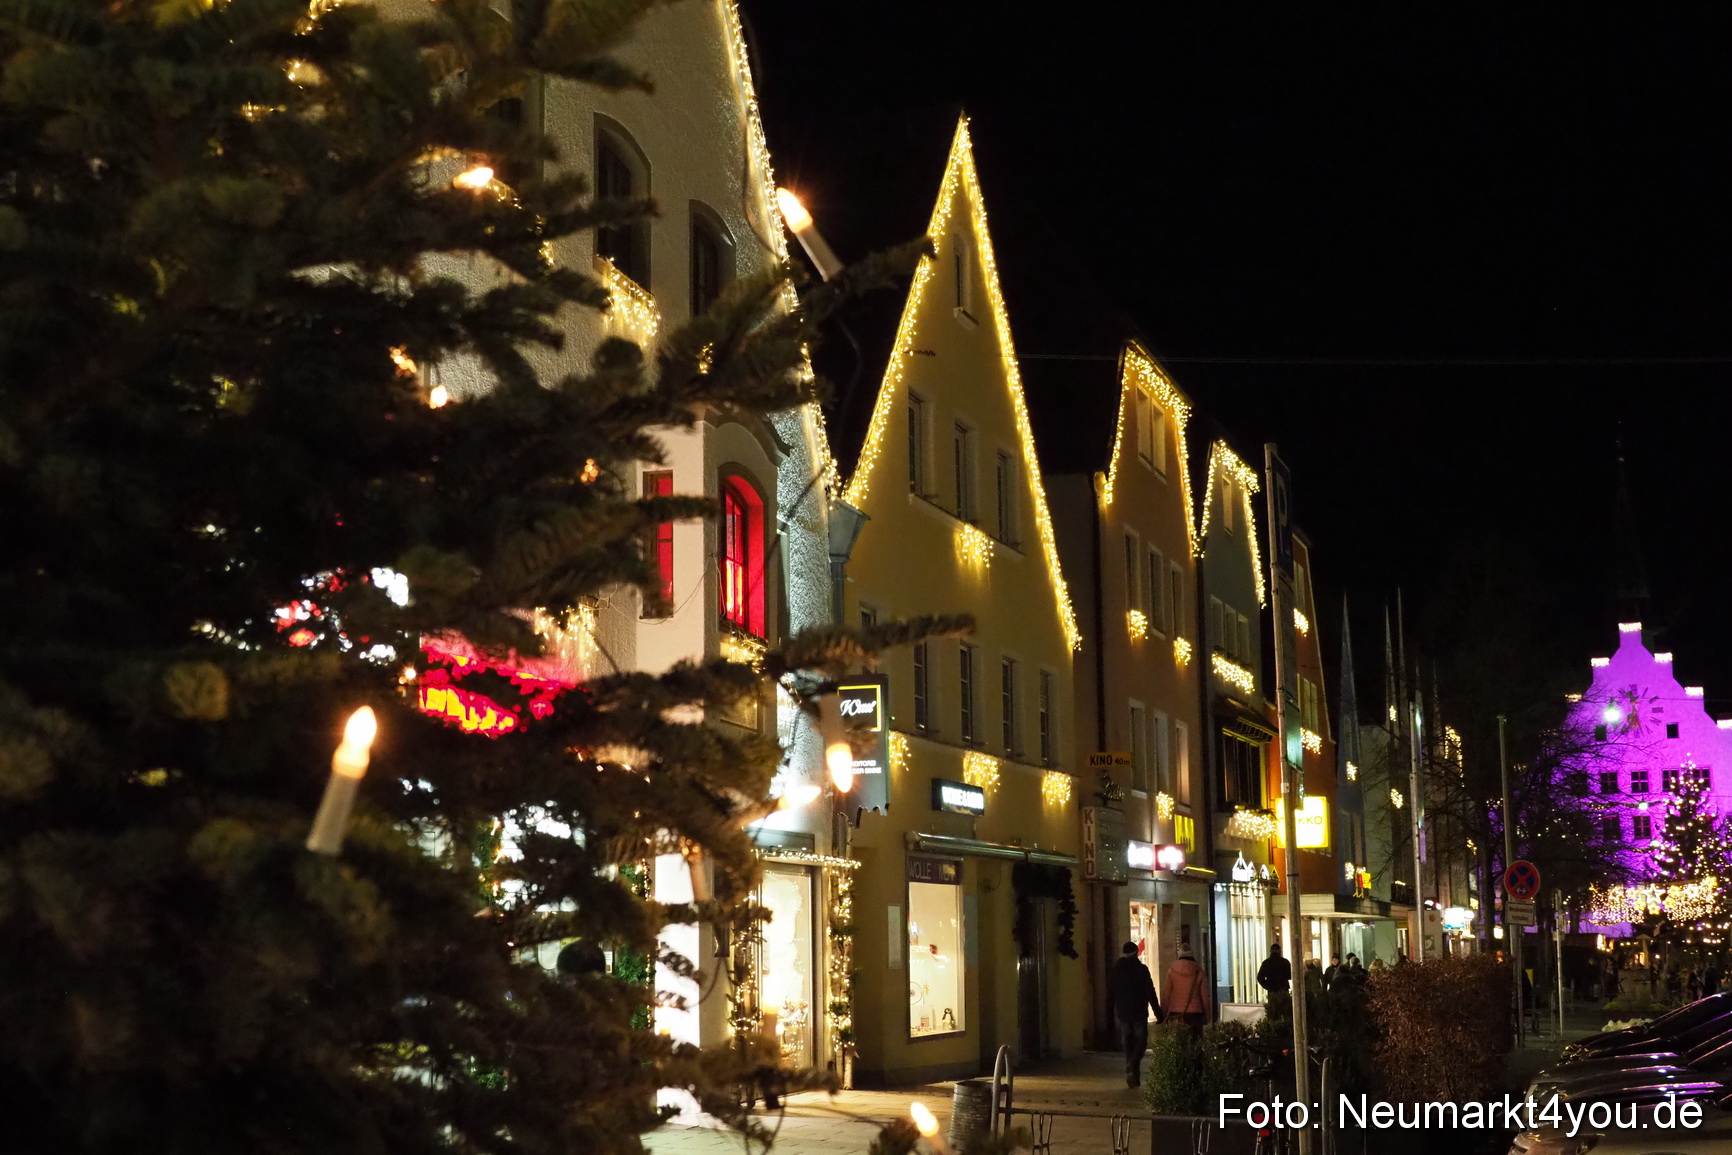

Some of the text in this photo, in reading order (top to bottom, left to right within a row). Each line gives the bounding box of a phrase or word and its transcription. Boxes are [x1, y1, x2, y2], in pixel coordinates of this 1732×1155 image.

[1090, 755, 1113, 766] KINO
[1084, 809, 1095, 876] KINO
[908, 860, 931, 880] WOLLE
